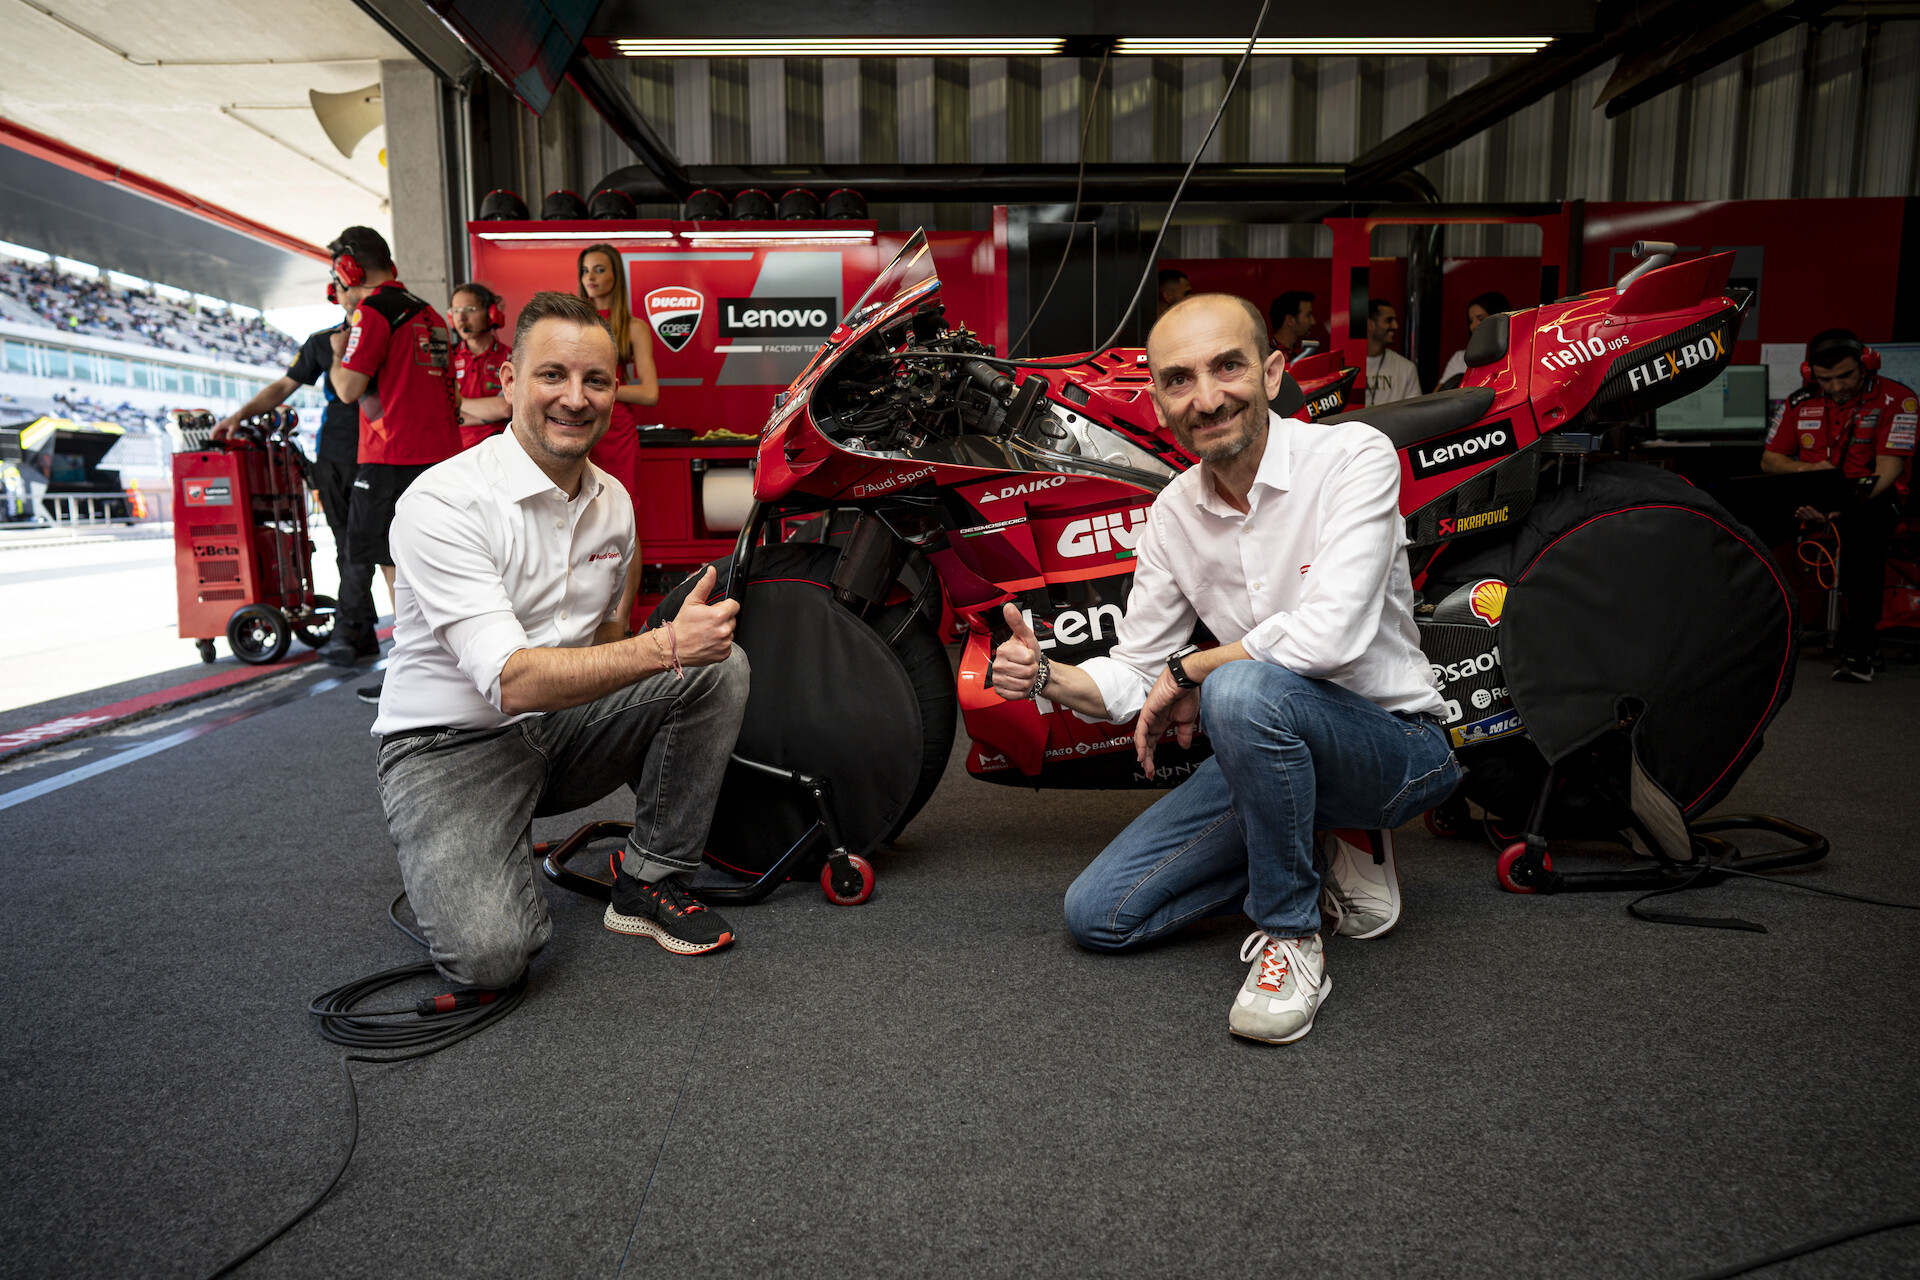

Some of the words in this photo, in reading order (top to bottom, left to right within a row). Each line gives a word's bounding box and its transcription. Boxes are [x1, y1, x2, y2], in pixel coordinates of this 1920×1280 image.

[651, 297, 698, 308] DUCATI
[660, 323, 692, 334] CORSE
[727, 305, 828, 329] Lenovo
[764, 344, 802, 353] FACTORY
[1541, 336, 1607, 371] riello
[1608, 334, 1630, 352] ups
[1627, 329, 1726, 393] FLEX-BOX
[1418, 430, 1507, 469] Lenovo
[868, 477, 897, 493] Audi
[897, 465, 937, 484] Sport
[1000, 475, 1067, 500] DAIKO
[959, 516, 1027, 534] DESMOSEDICI
[1457, 505, 1509, 533] AKRAPOVIČ
[207, 545, 239, 556] Beta
[596, 552, 608, 560] Audi
